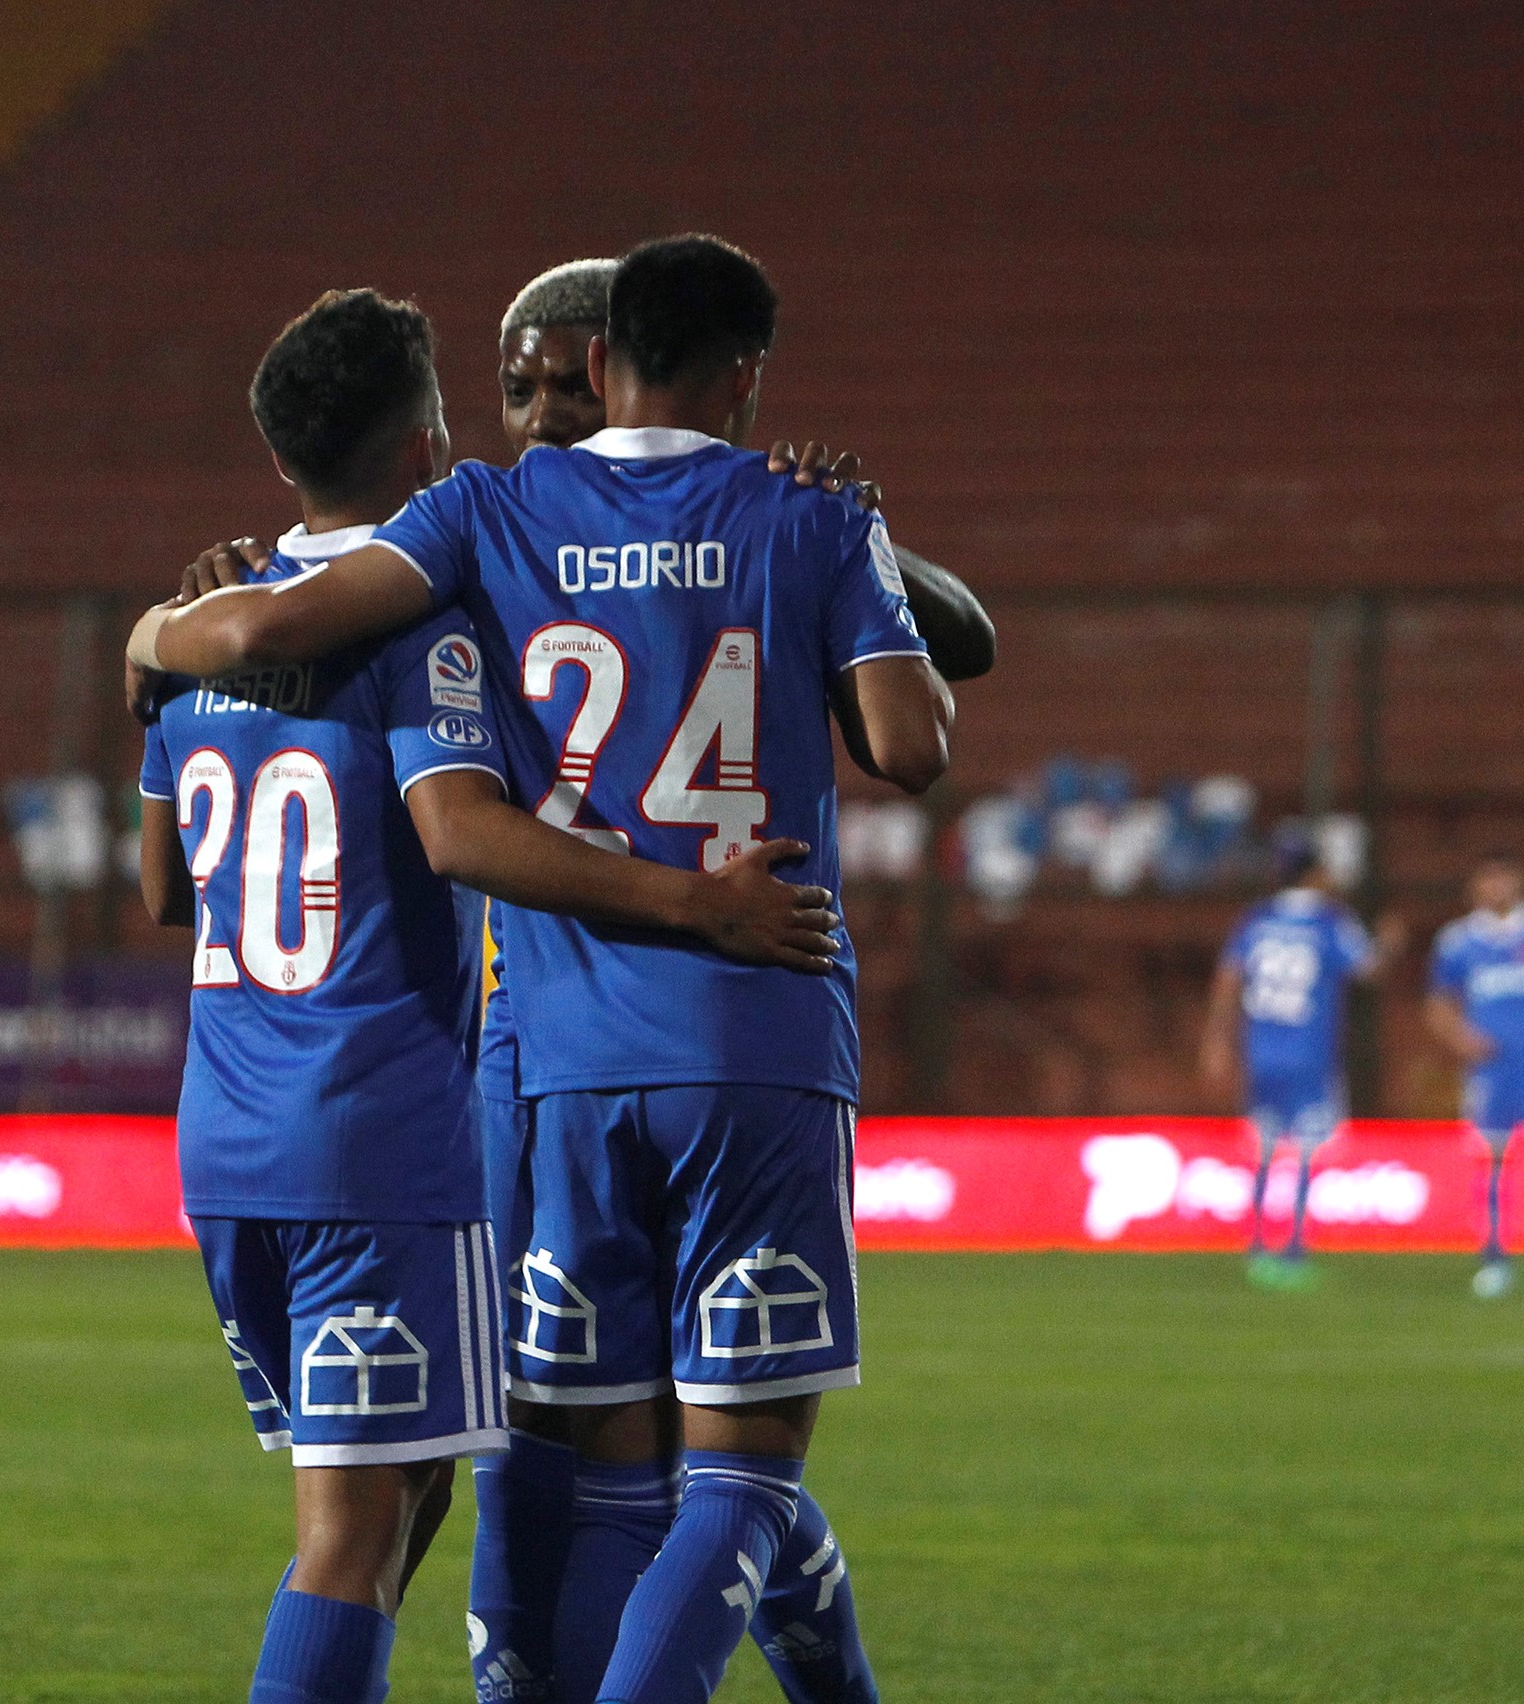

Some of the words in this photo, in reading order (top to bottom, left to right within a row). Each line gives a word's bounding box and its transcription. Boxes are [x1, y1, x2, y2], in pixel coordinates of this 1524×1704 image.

[557, 540, 726, 594] OSORIO
[445, 716, 477, 741] PF
[520, 620, 770, 873] 24
[178, 746, 341, 996] 20
